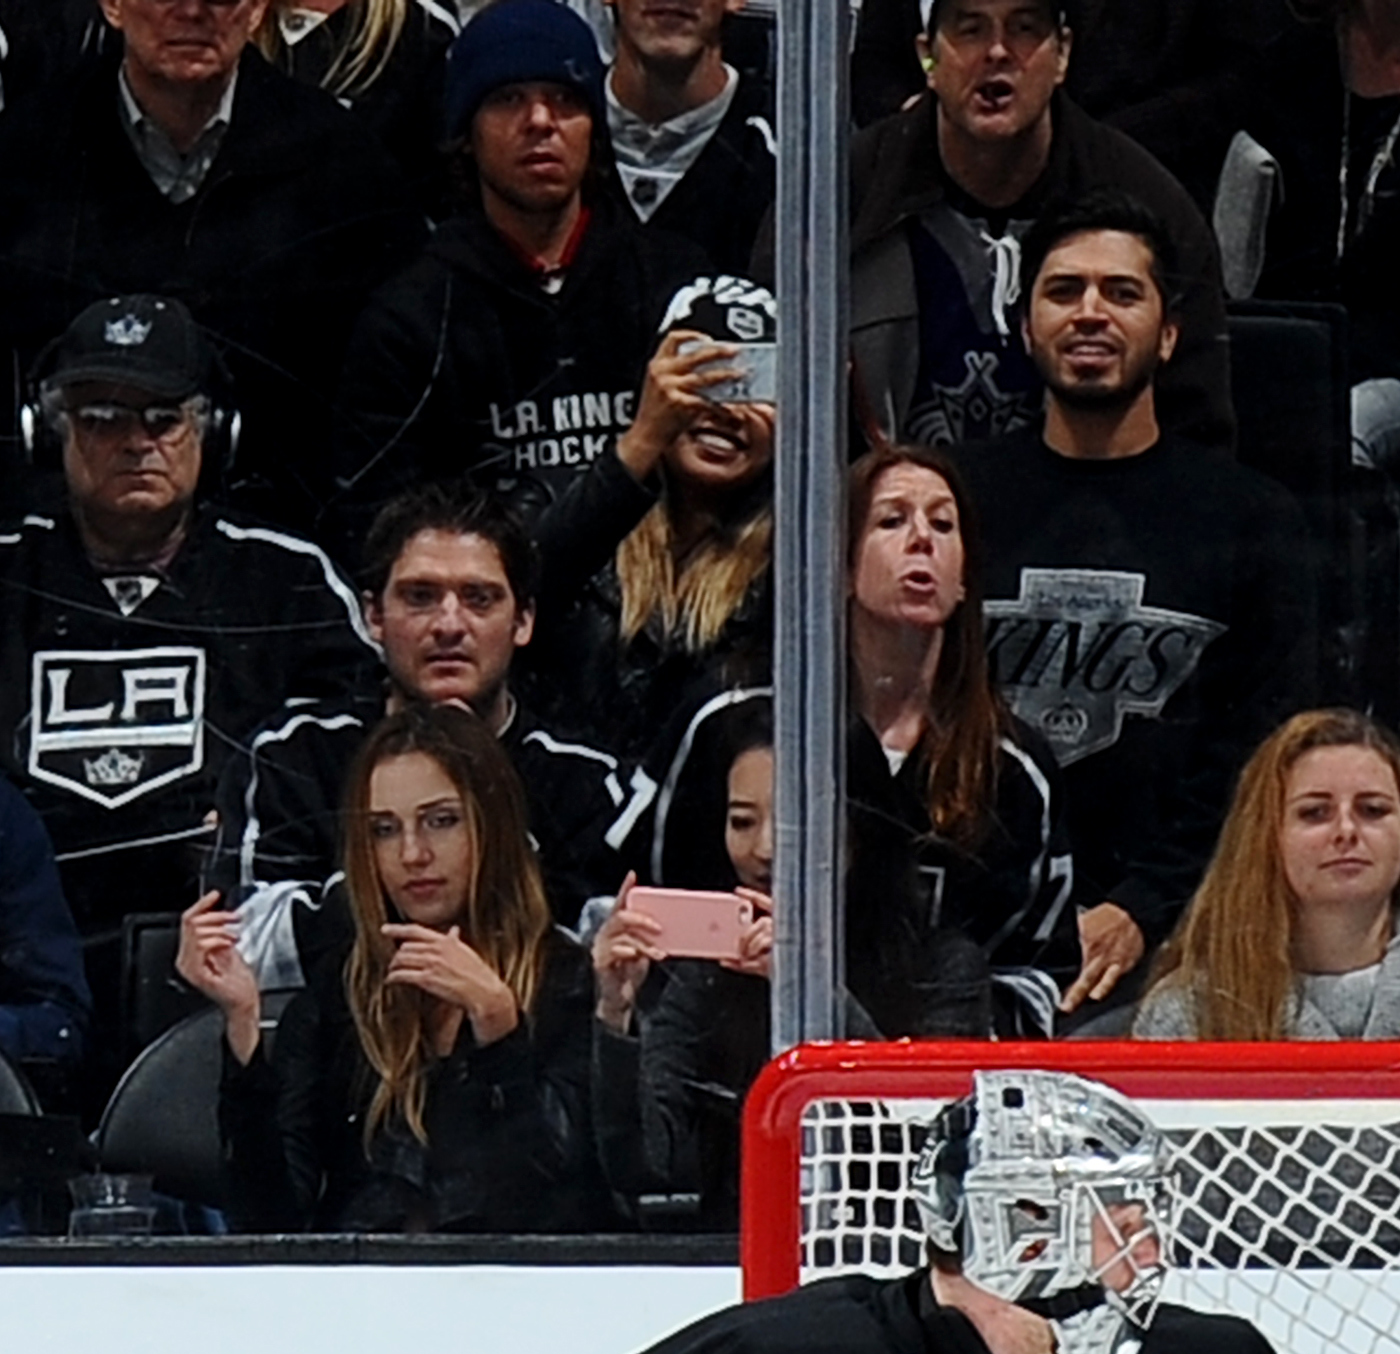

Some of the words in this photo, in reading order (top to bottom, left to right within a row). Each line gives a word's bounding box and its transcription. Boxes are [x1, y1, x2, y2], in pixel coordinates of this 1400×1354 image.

[552, 391, 635, 432] KING
[515, 434, 608, 470] HOCK
[48, 667, 190, 724] LA
